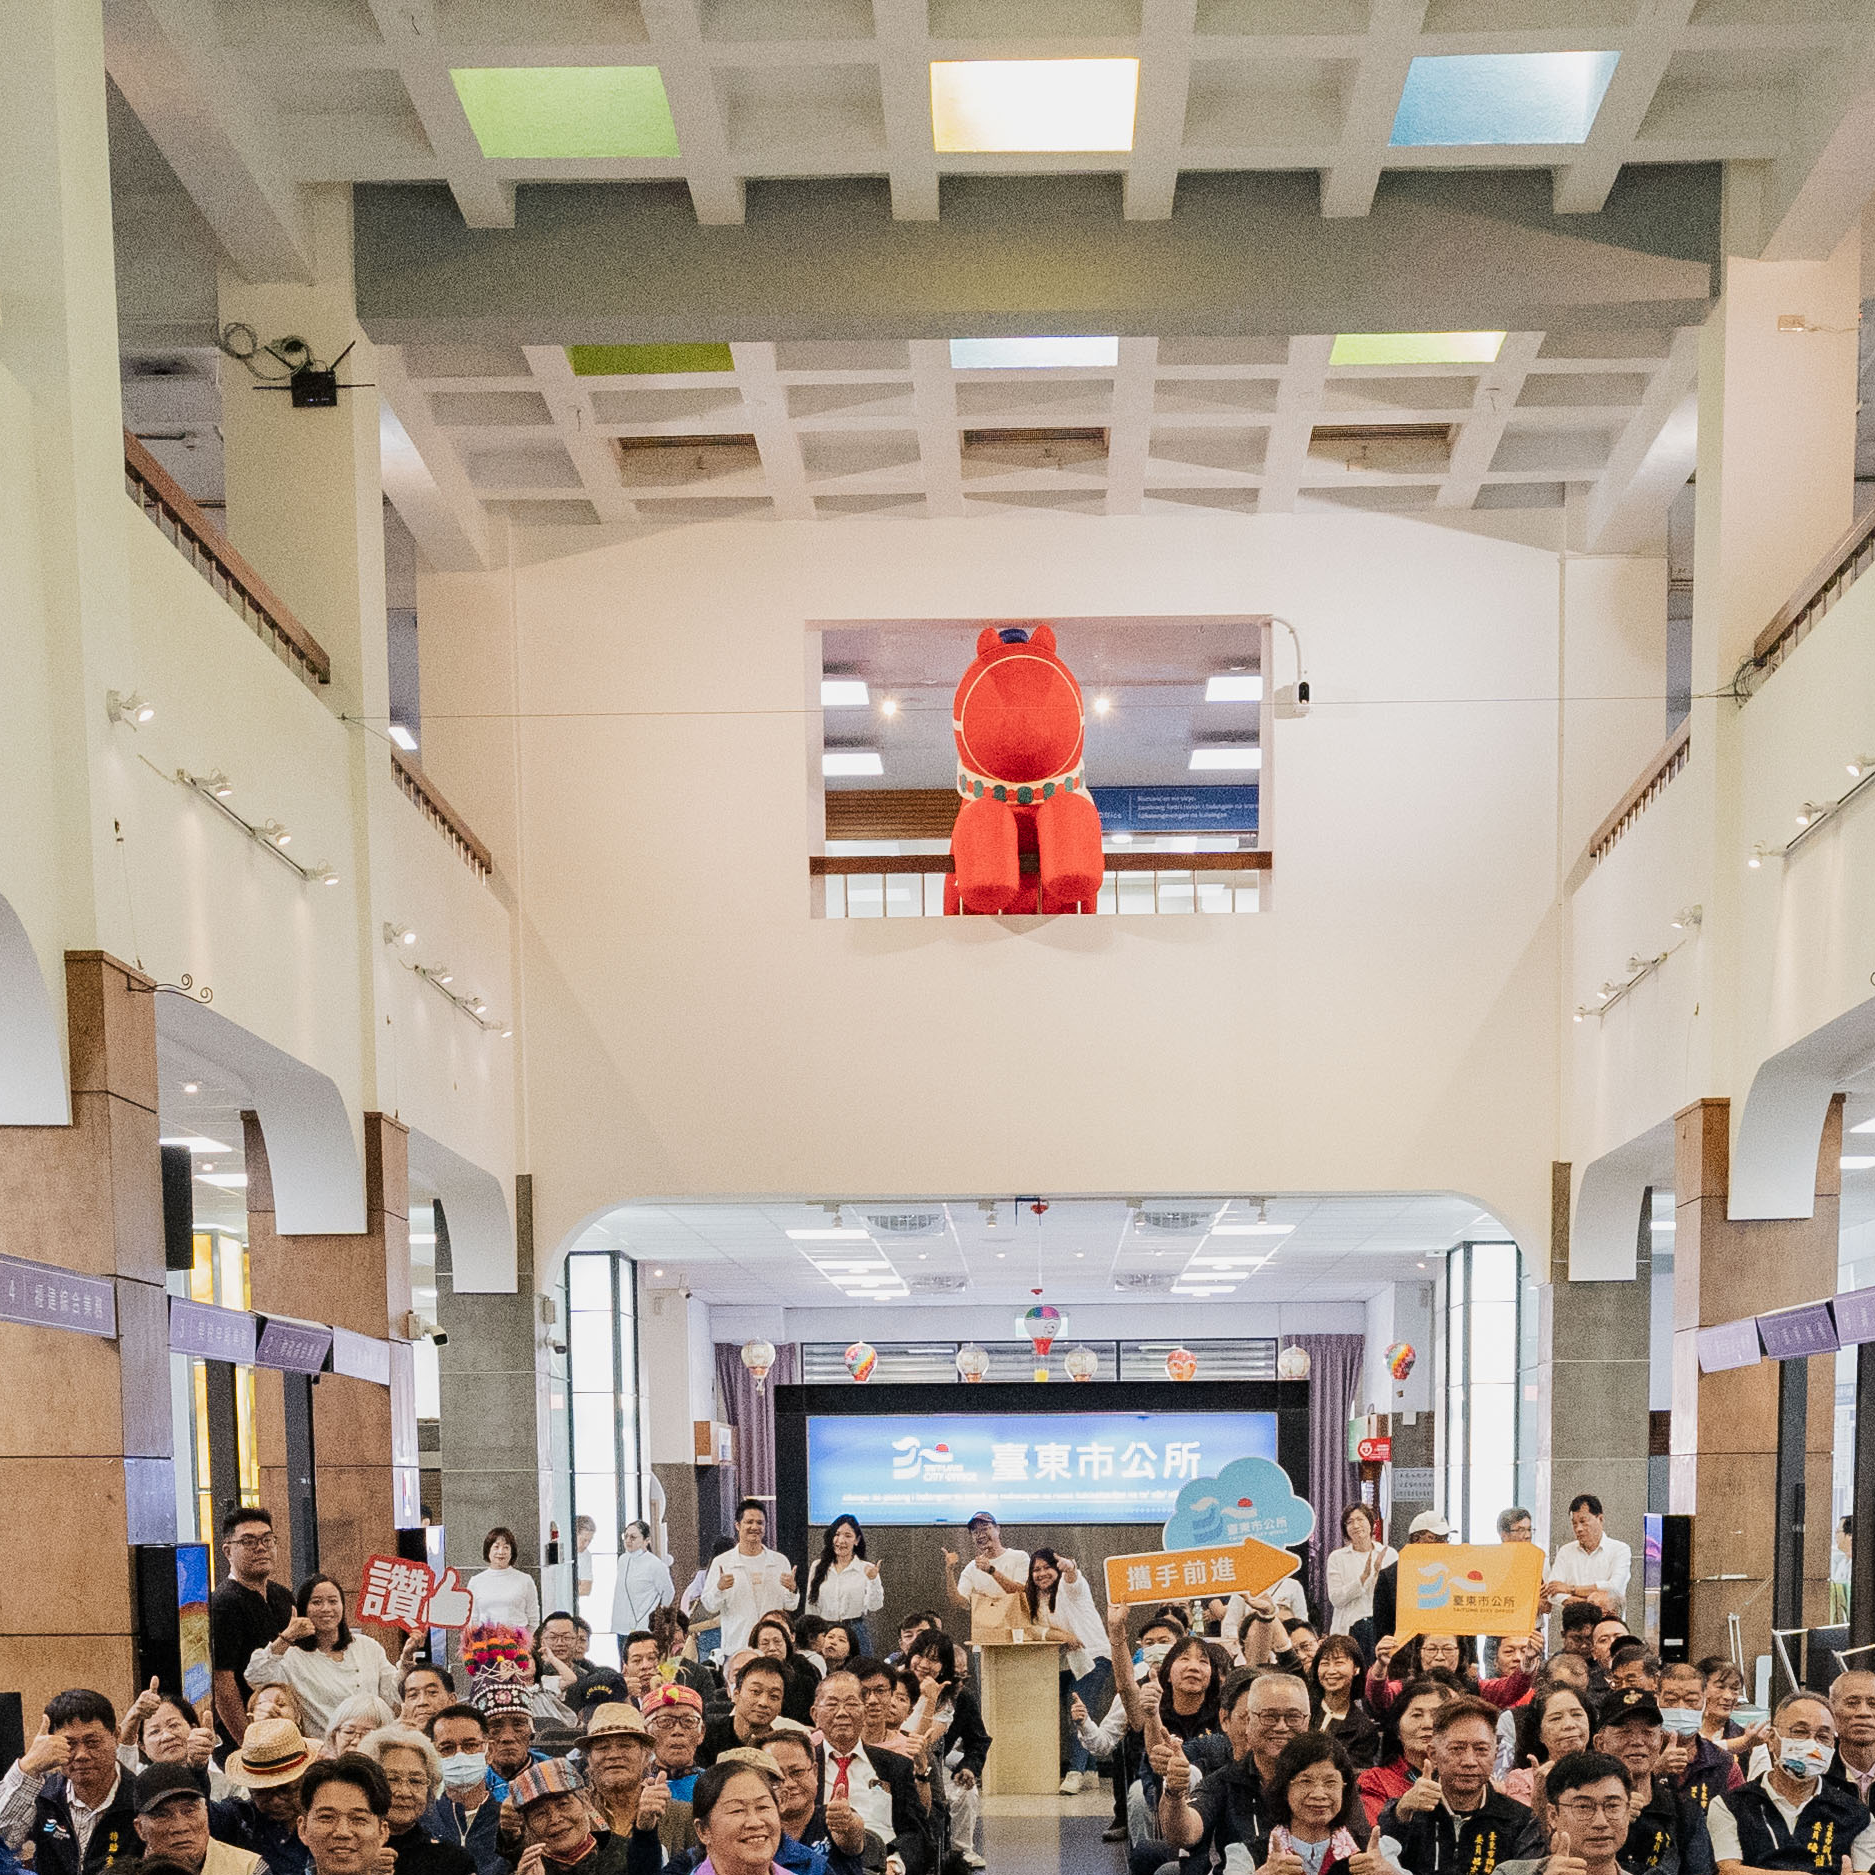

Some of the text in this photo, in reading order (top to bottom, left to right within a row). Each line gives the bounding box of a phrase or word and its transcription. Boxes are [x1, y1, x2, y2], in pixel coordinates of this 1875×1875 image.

[991, 1440, 1203, 1482] 臺東市公所
[1125, 1556, 1238, 1593] 攜手前進
[360, 1560, 431, 1631] 讚
[1452, 1594, 1516, 1608] 臺東市公所
